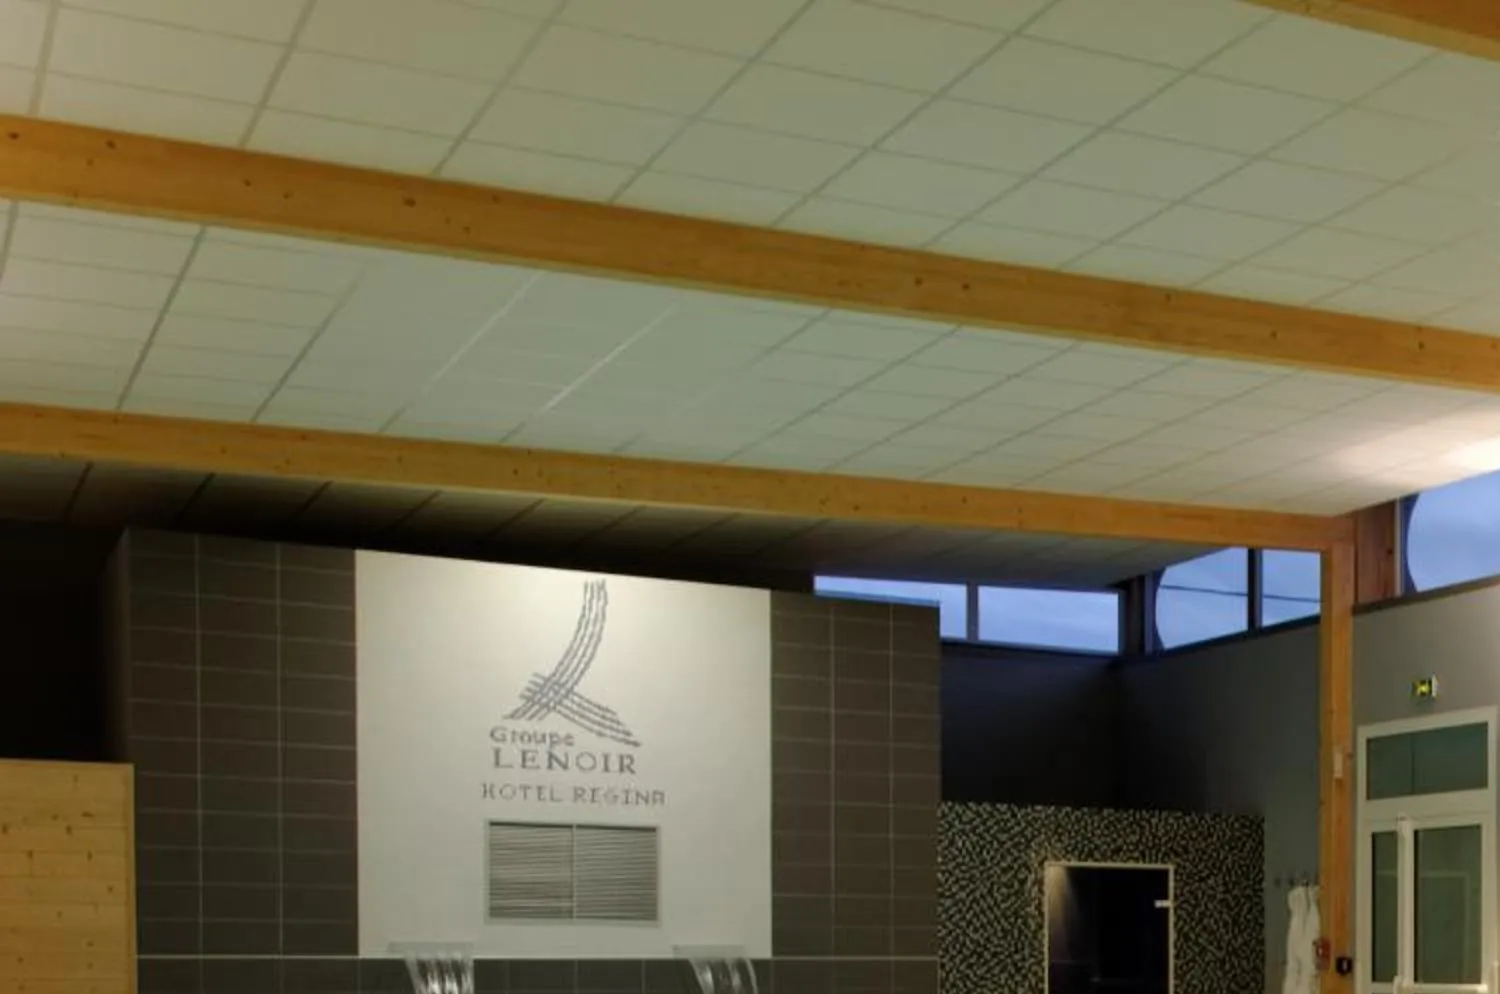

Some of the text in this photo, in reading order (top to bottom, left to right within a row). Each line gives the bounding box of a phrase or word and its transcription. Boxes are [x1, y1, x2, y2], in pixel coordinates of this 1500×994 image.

[489, 726, 575, 748] Groupe
[493, 748, 636, 774] LENOIR
[482, 783, 666, 806] HOTEL REGINA
